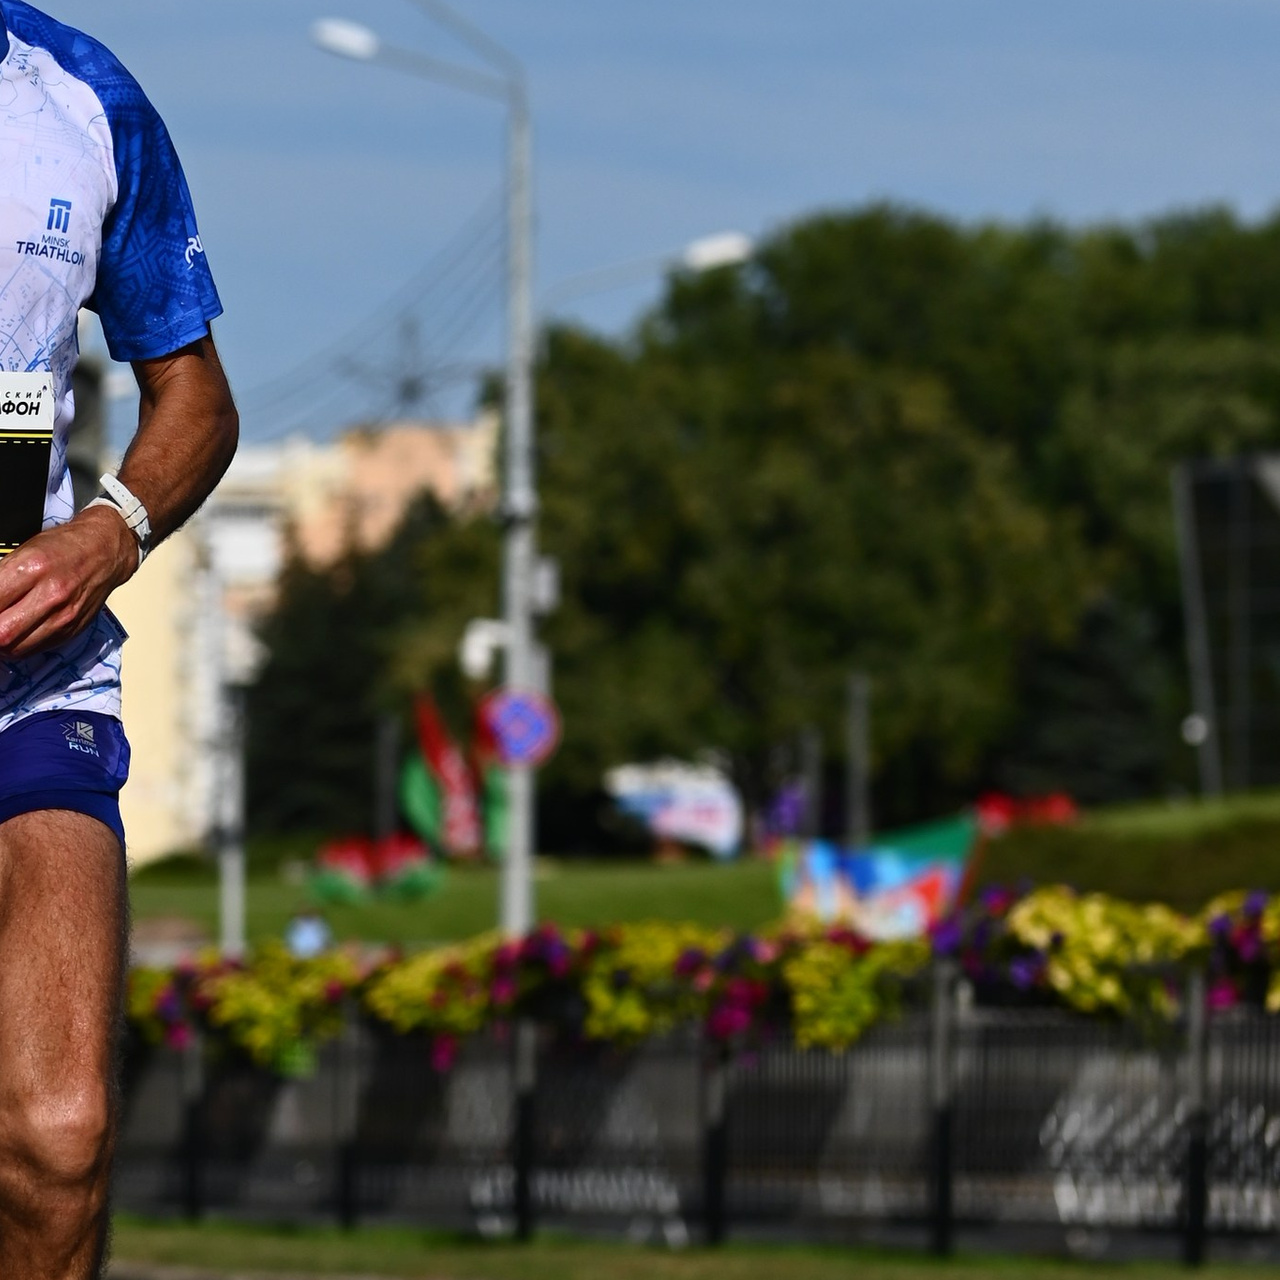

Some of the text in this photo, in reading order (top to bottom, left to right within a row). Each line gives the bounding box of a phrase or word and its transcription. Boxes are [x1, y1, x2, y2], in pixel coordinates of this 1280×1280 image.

[41, 234, 70, 248] MINSK
[16, 241, 86, 267] TRIATHLON
[68, 741, 100, 757] RUN
